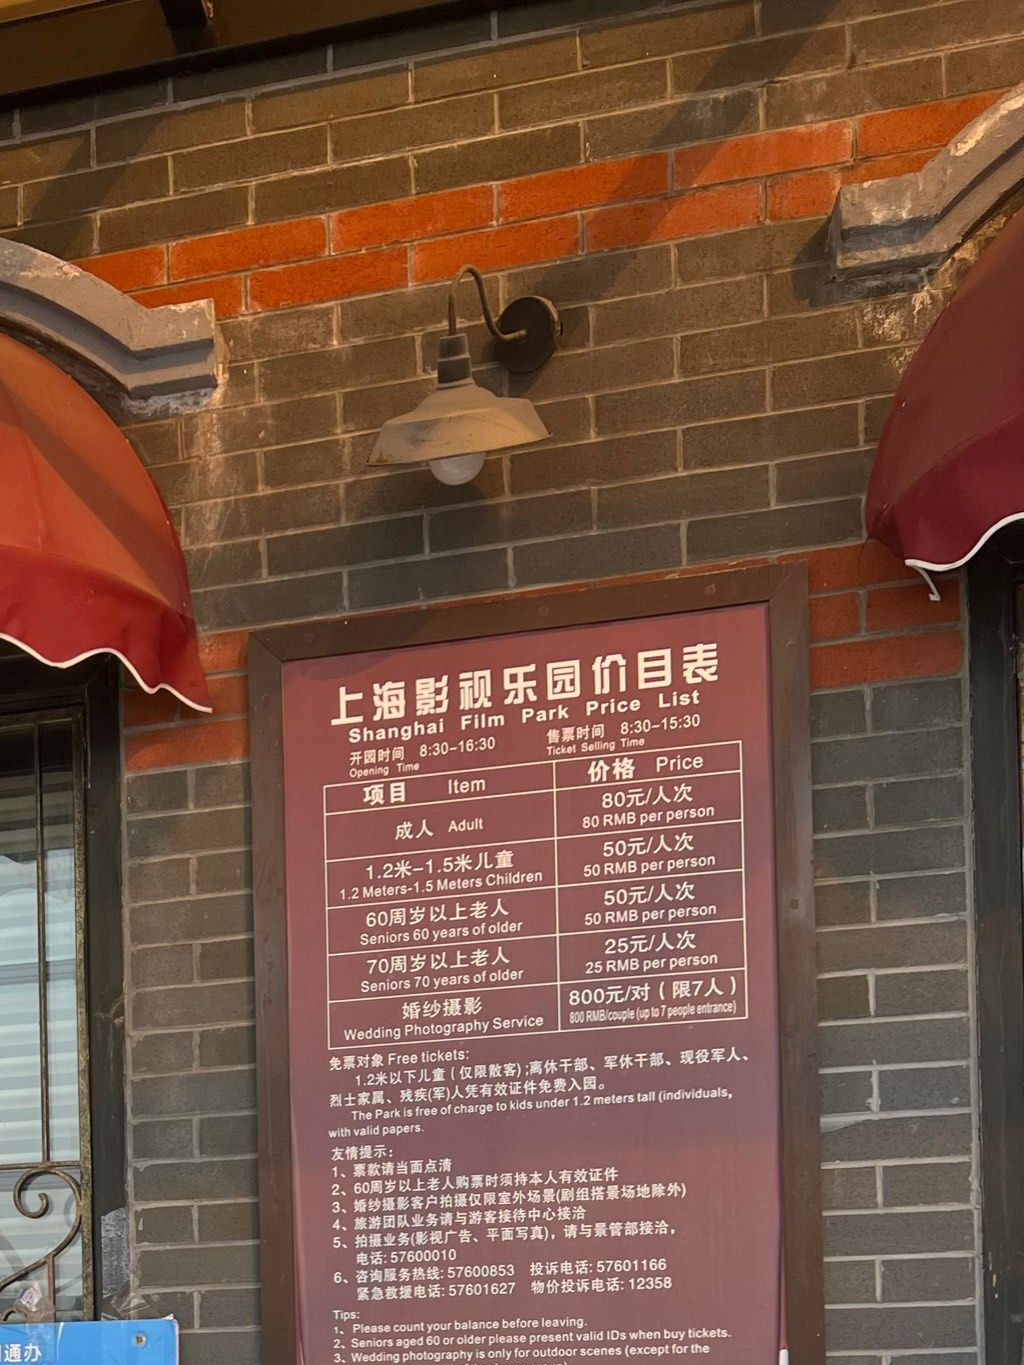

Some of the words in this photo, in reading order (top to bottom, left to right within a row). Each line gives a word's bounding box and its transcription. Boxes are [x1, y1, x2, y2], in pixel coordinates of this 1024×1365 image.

[331, 643, 718, 725] 上海影视乐园价目表
[349, 719, 443, 743] Shanghai
[461, 714, 504, 730] Film
[522, 705, 569, 723] Park
[586, 699, 640, 716] Price
[659, 690, 699, 707] List
[547, 744, 576, 755] Ticket
[581, 741, 615, 752] Selling
[620, 738, 645, 747] Time
[350, 767, 389, 778] Opening
[397, 763, 419, 772] Time
[588, 758, 636, 782] 价格
[656, 755, 704, 772] Price
[363, 782, 407, 806] 项目
[448, 778, 487, 795] Item
[602, 783, 693, 808] 80元/人次
[395, 820, 433, 840] 成人
[448, 818, 483, 832] Adult
[603, 833, 694, 857] 50元/人次
[340, 887, 359, 901] 1.2
[362, 880, 434, 898] Meters-1.5
[437, 878, 482, 891] Meters
[486, 872, 542, 886] Children
[366, 899, 508, 927] 60周岁以上老人
[360, 932, 409, 945] Seniors
[413, 928, 429, 940] 60
[433, 927, 469, 942] years
[473, 923, 485, 935] of
[488, 921, 522, 934] older
[402, 997, 482, 1019] 婚纱摄影
[344, 1027, 400, 1040] Wedding
[405, 1019, 489, 1036] Photography
[493, 1016, 543, 1029] Service
[329, 1054, 383, 1070] 免票对象
[389, 1053, 417, 1065] Free
[421, 1050, 469, 1062] tickets:
[357, 1251, 386, 1265] 电话:
[391, 1249, 456, 1263] 57600010
[530, 1260, 592, 1276] 投诉电话:
[597, 1258, 666, 1272] 57601166
[531, 1277, 624, 1294] 物价投诉电话:
[629, 1277, 672, 1289] 12358
[353, 1324, 390, 1333] Please
[393, 1323, 424, 1332] count
[427, 1323, 452, 1333] your
[455, 1320, 499, 1330] balance
[502, 1318, 539, 1328] before
[541, 1317, 588, 1329] leaving.
